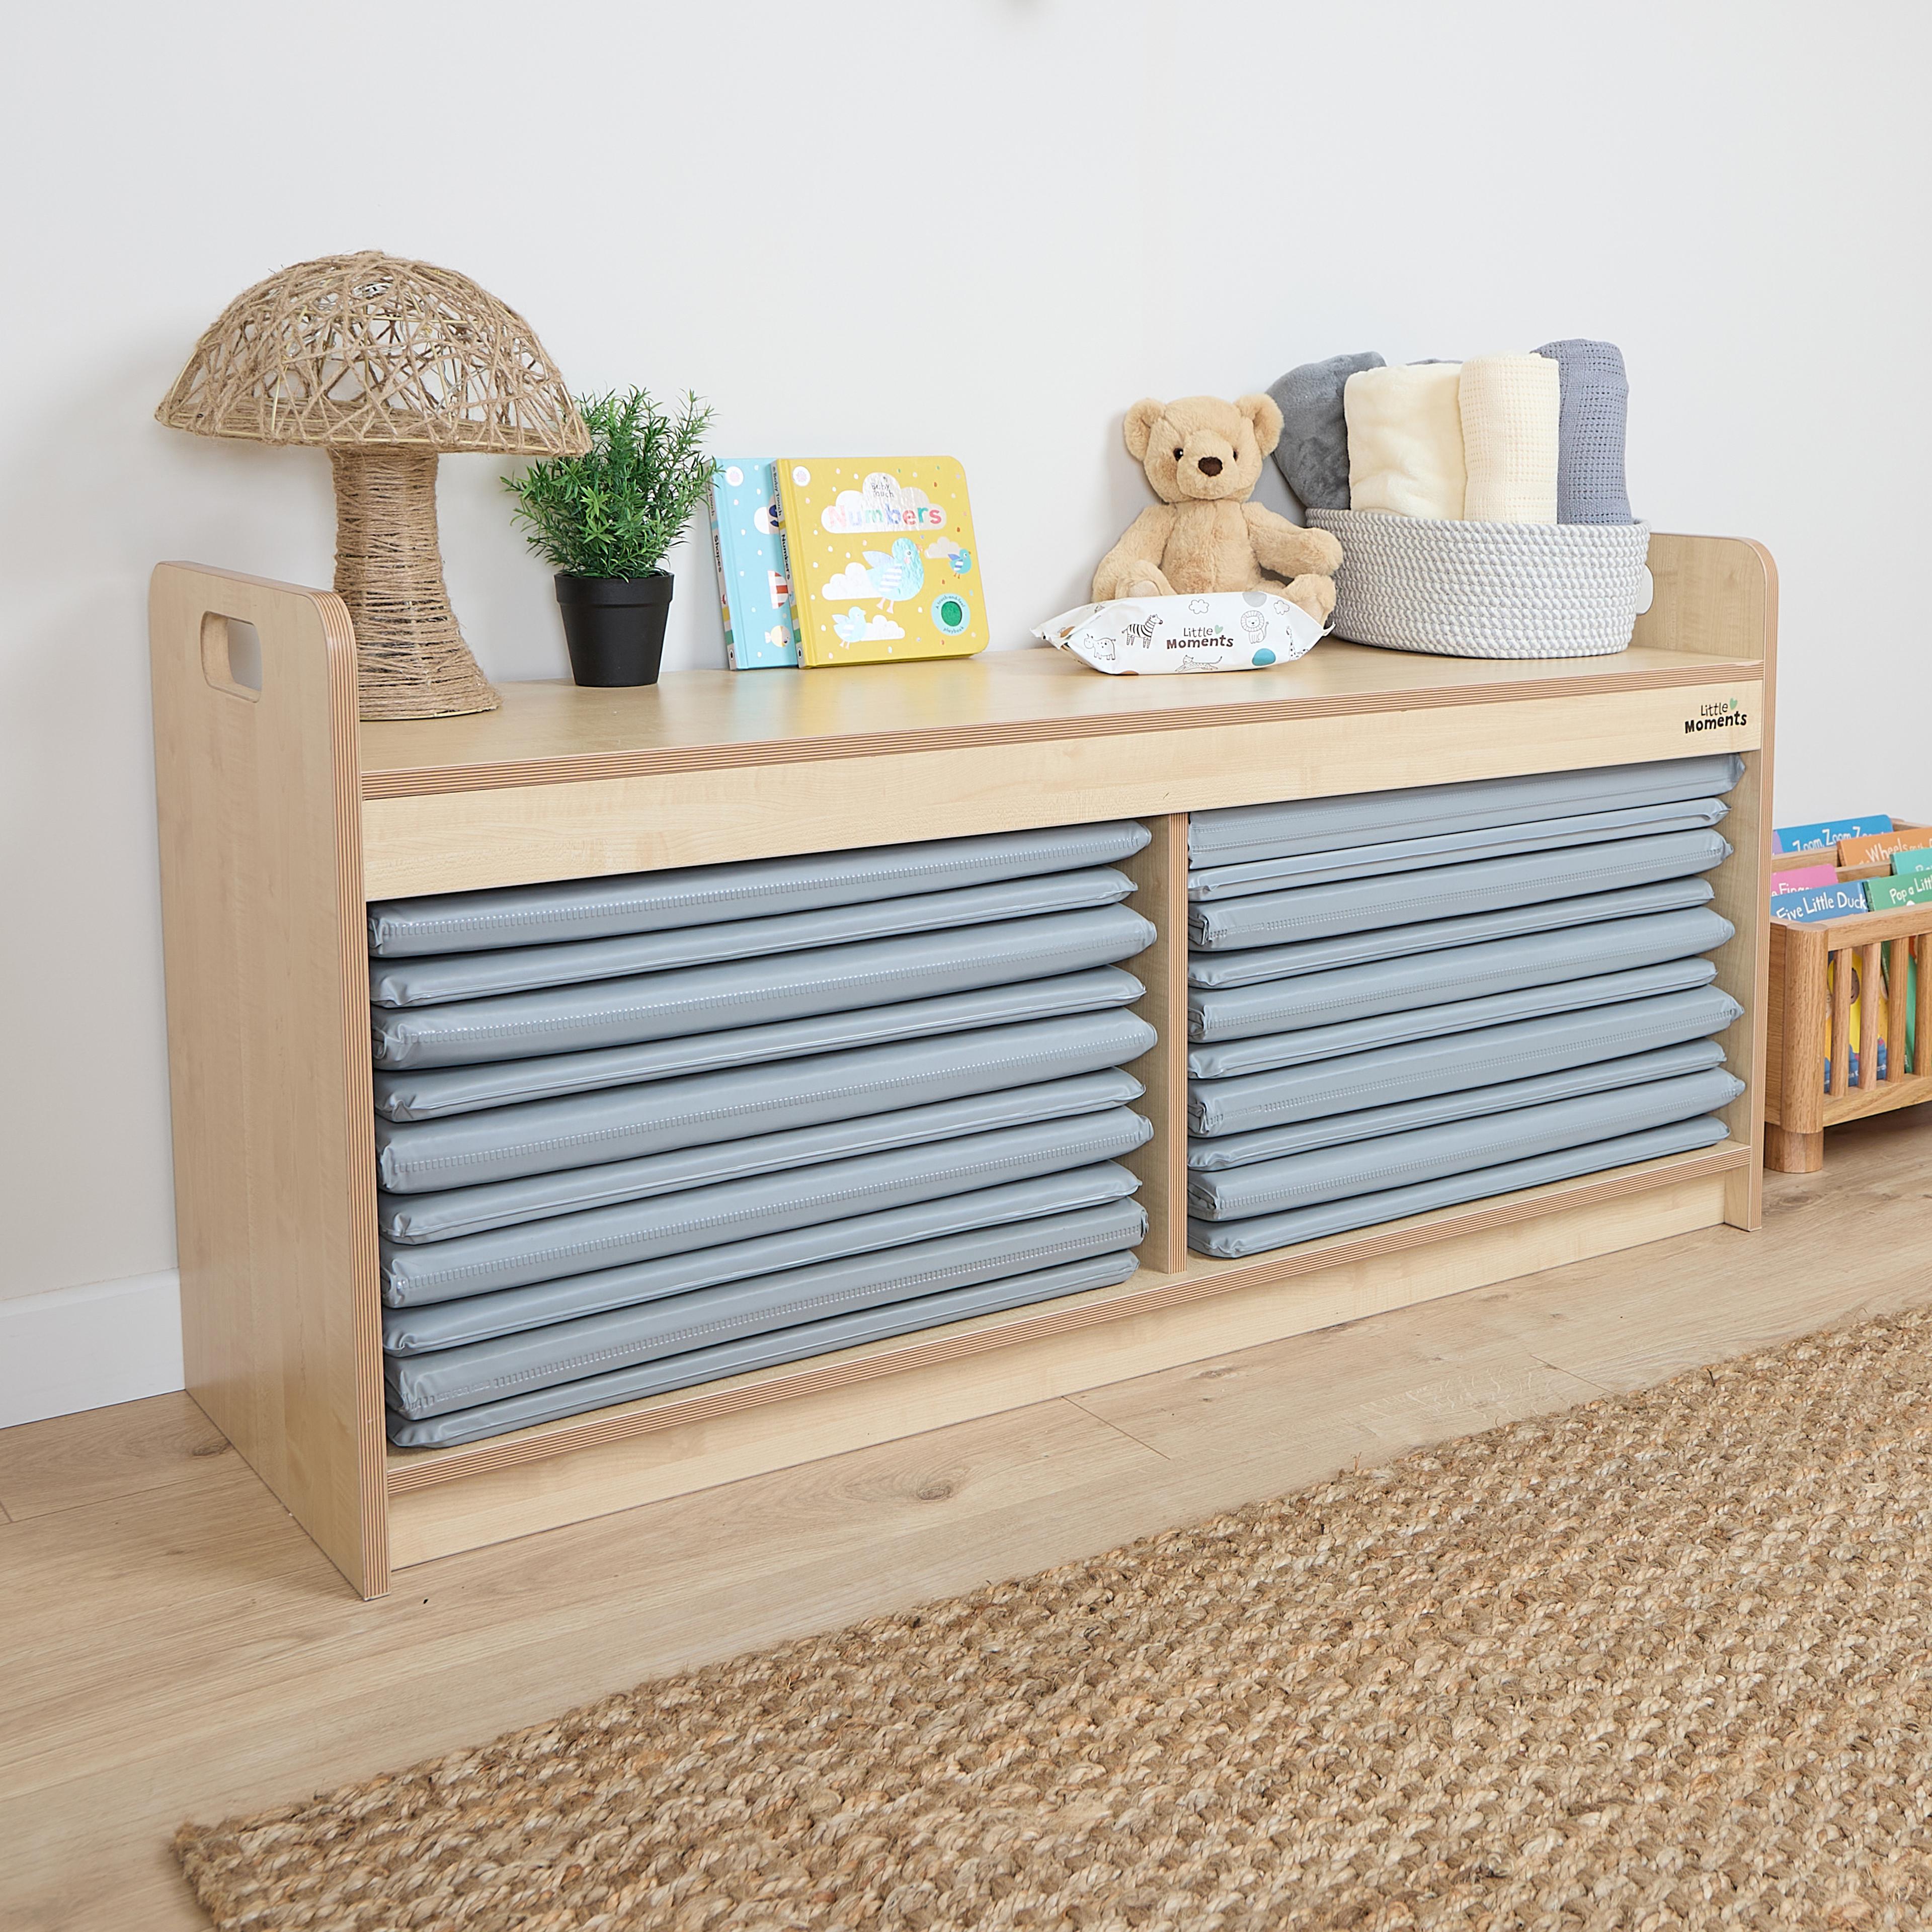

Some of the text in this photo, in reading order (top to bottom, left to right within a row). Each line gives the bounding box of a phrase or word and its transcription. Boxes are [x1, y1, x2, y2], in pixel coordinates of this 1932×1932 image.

[828, 504, 942, 527] Numbers
[781, 534, 791, 580] Numbers
[1167, 635, 1234, 650] Moments
[1184, 627, 1213, 637] Little
[1701, 702, 1728, 716] Little
[1685, 711, 1747, 734] Moments
[1865, 838, 1908, 862] Wheels
[1889, 874, 1932, 904] Pop a Litt
[1776, 907, 1804, 920] Five
[1803, 892, 1834, 914] Little
